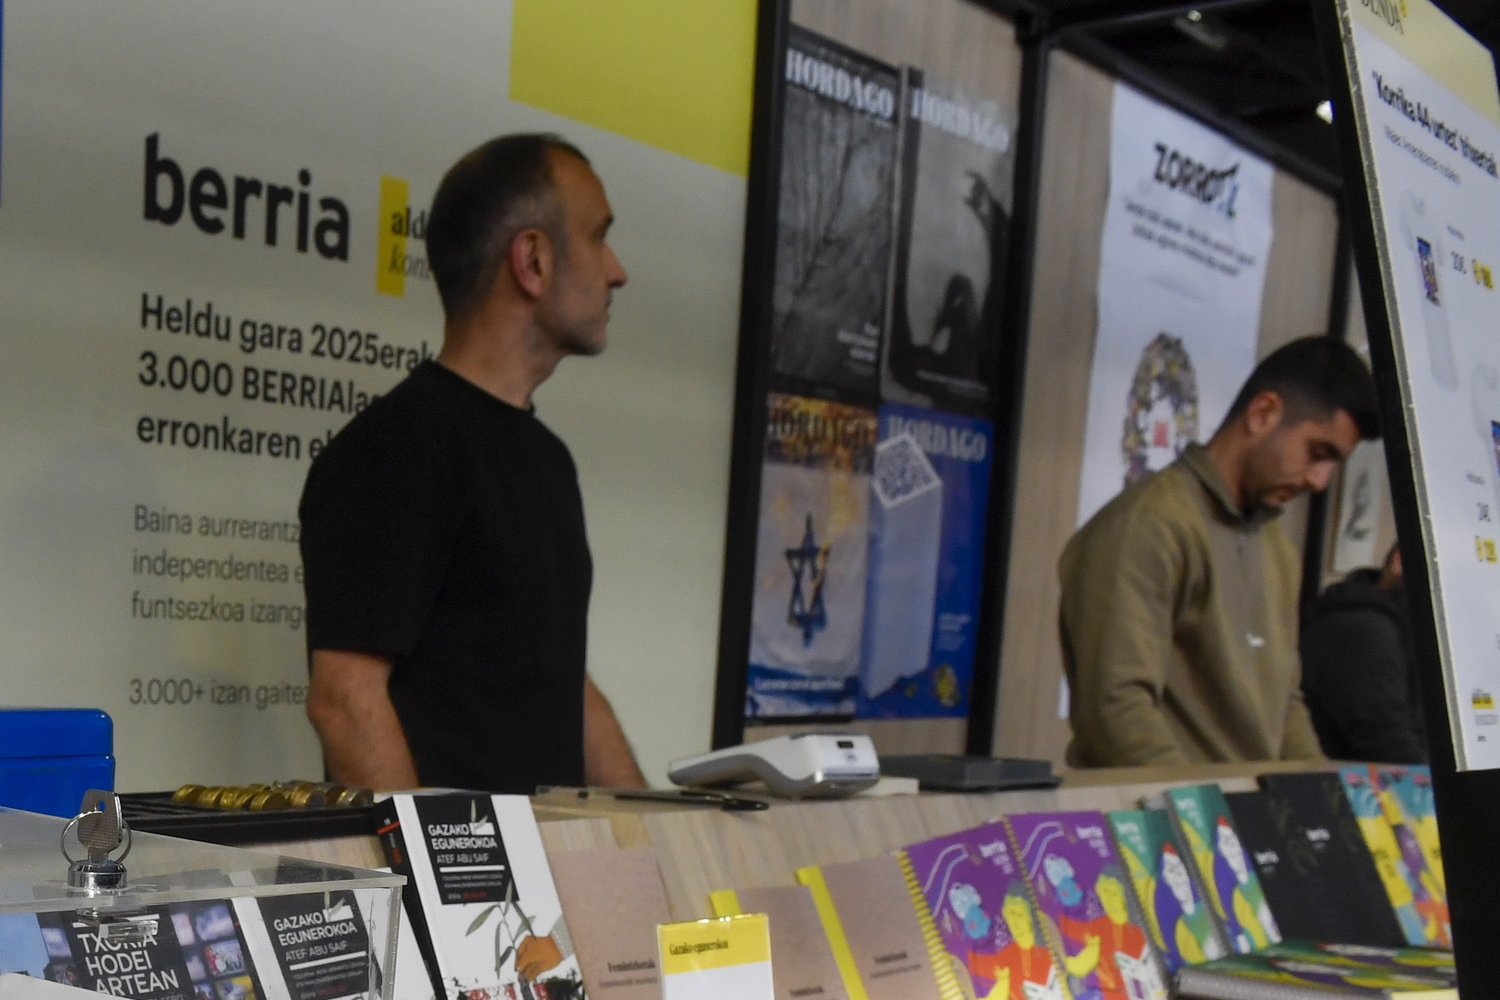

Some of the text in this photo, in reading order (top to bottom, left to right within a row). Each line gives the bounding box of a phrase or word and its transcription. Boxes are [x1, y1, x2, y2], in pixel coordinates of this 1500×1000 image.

[143, 131, 349, 262] berria
[141, 293, 303, 354] Heldu gara
[138, 351, 233, 398] 3.000
[137, 415, 301, 461] erronkaren
[134, 504, 193, 535] Baina
[132, 548, 291, 584] independentea
[132, 590, 246, 623] funtsezkoa
[129, 677, 252, 706] 3.000+ izan
[427, 823, 470, 837] GAZAKO
[432, 837, 498, 851] EGUNEROKOA
[437, 853, 455, 865] ATEF
[456, 853, 473, 864] ABU
[274, 912, 323, 932] GAZAKO
[278, 921, 358, 947] EGUNEROKOA
[85, 950, 153, 977] HODEI
[286, 948, 307, 962] ATEF
[309, 945, 329, 957] ABU
[96, 969, 181, 996] ARTEAN
